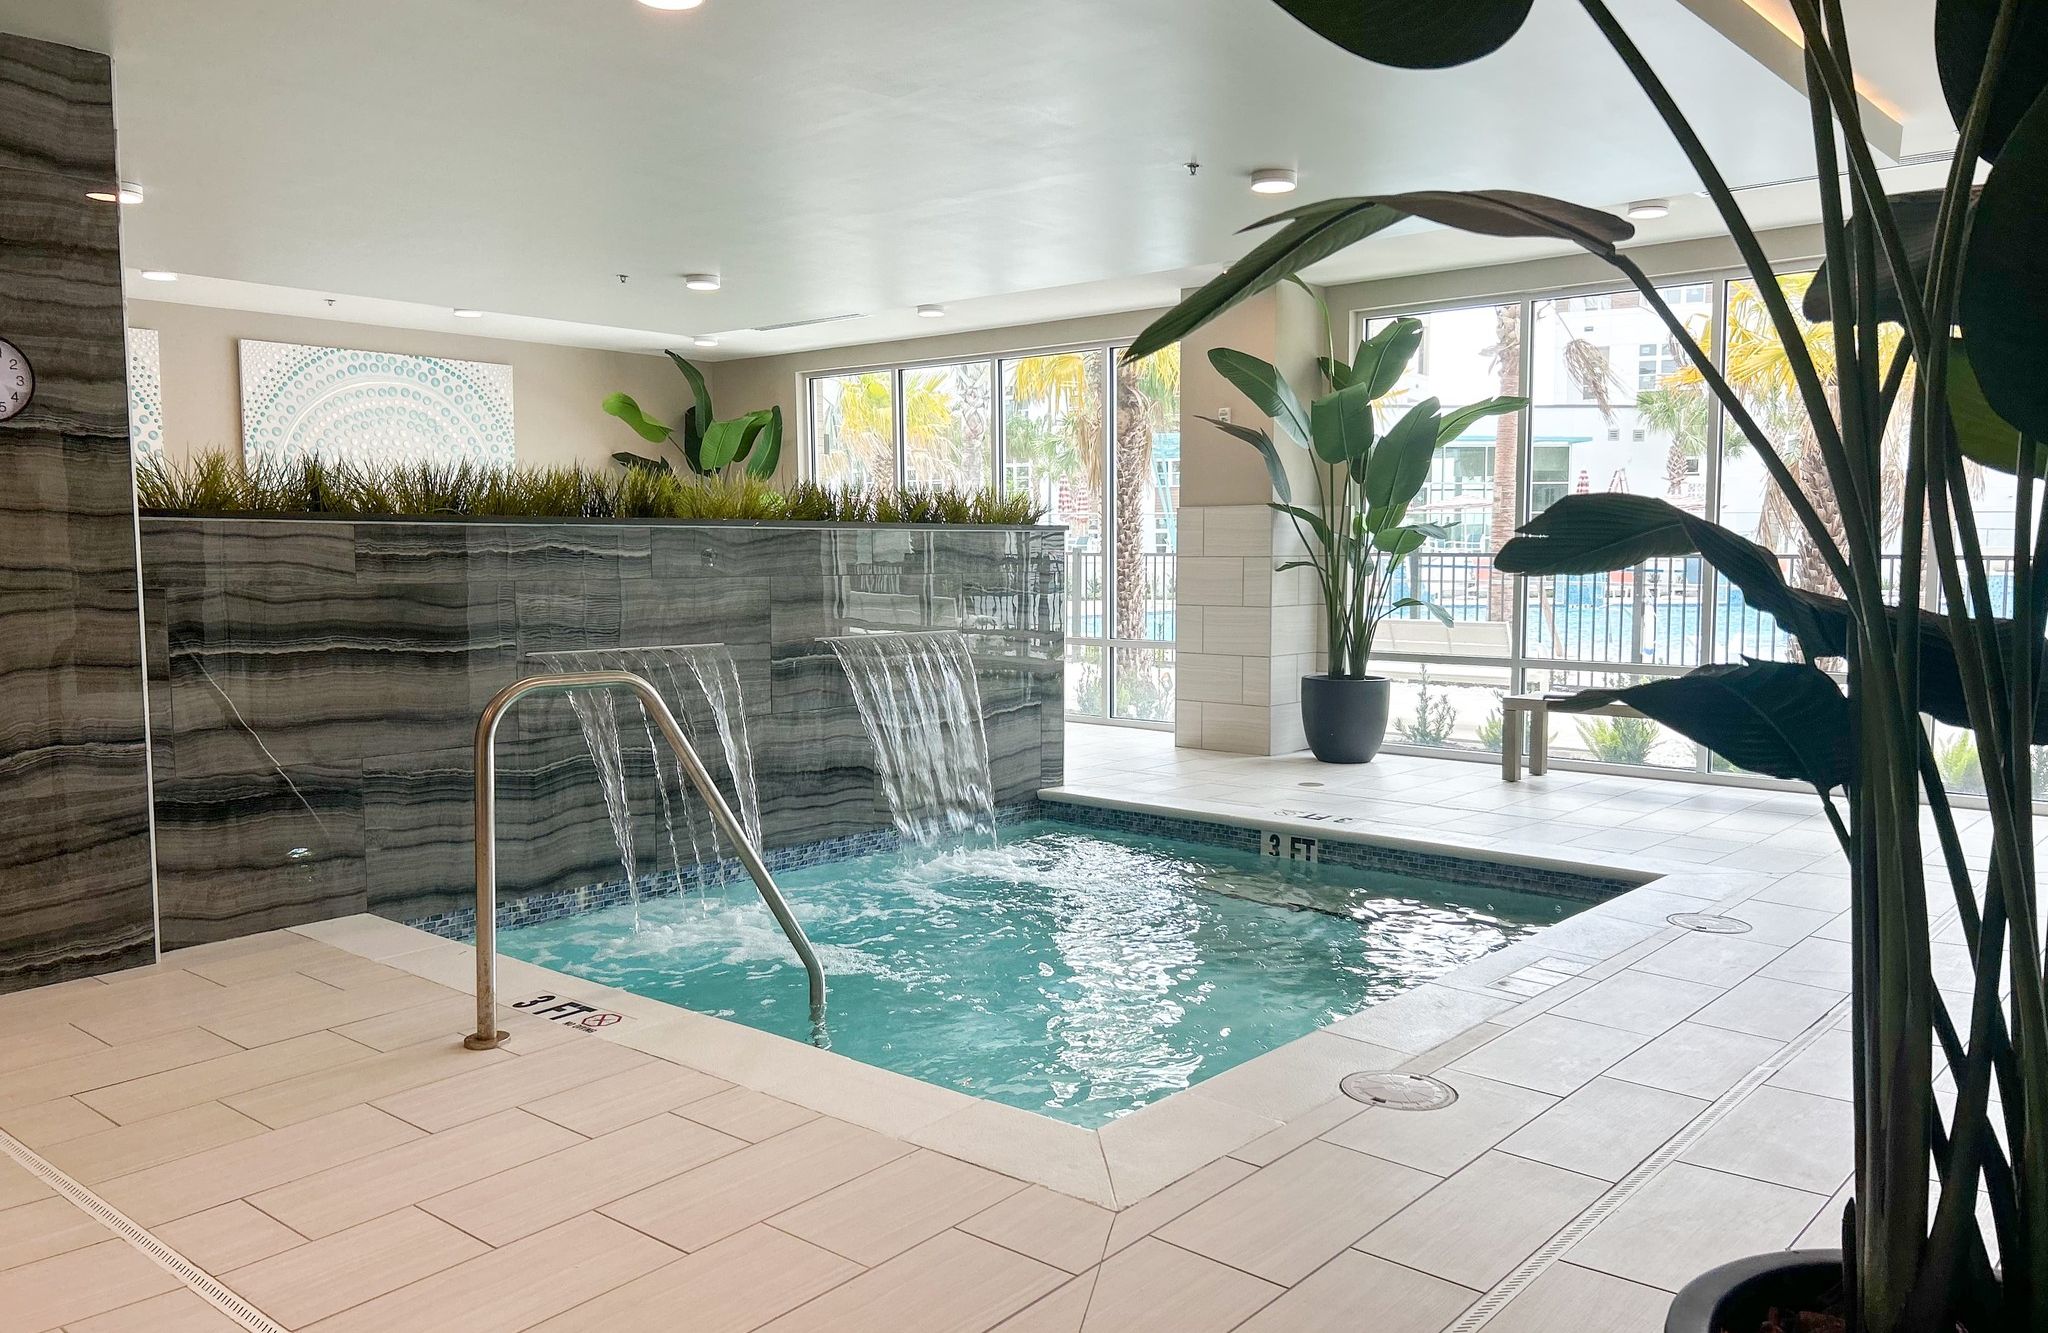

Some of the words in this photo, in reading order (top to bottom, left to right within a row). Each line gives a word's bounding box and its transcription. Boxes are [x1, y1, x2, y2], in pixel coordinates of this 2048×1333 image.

[9, 359, 18, 370] 2
[16, 376, 25, 386] 3
[11, 392, 19, 402] 4
[0, 402, 7, 412] 5
[1268, 833, 1281, 857] 3
[1290, 836, 1316, 862] FT
[512, 995, 556, 1009] 3
[532, 1001, 598, 1021] FT
